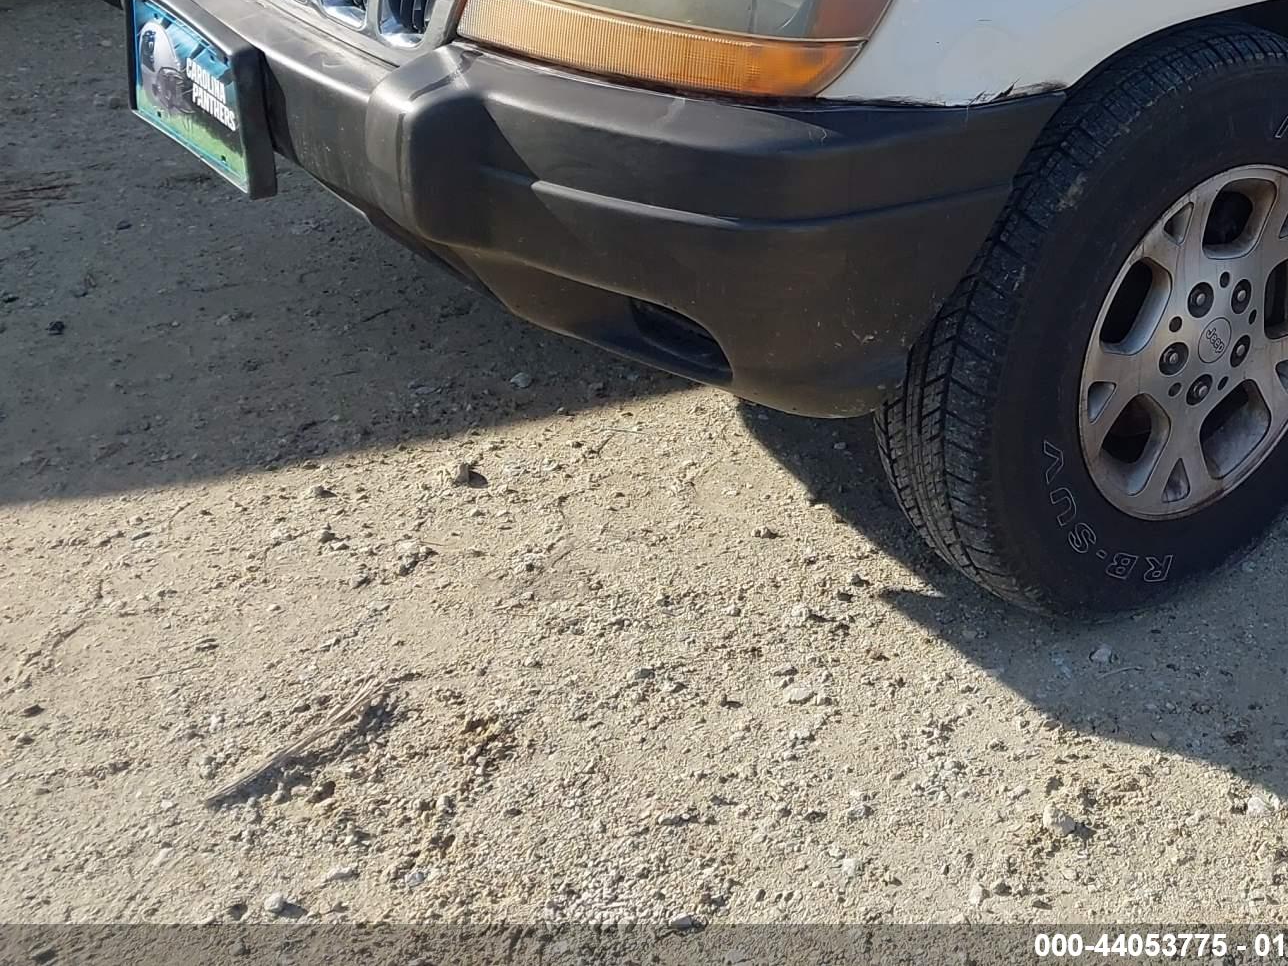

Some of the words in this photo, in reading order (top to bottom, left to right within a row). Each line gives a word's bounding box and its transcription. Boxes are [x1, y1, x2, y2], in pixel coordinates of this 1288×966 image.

[186, 57, 227, 105] CAROLINA
[192, 84, 237, 132] PANTHERS
[1206, 327, 1225, 353] Jeep
